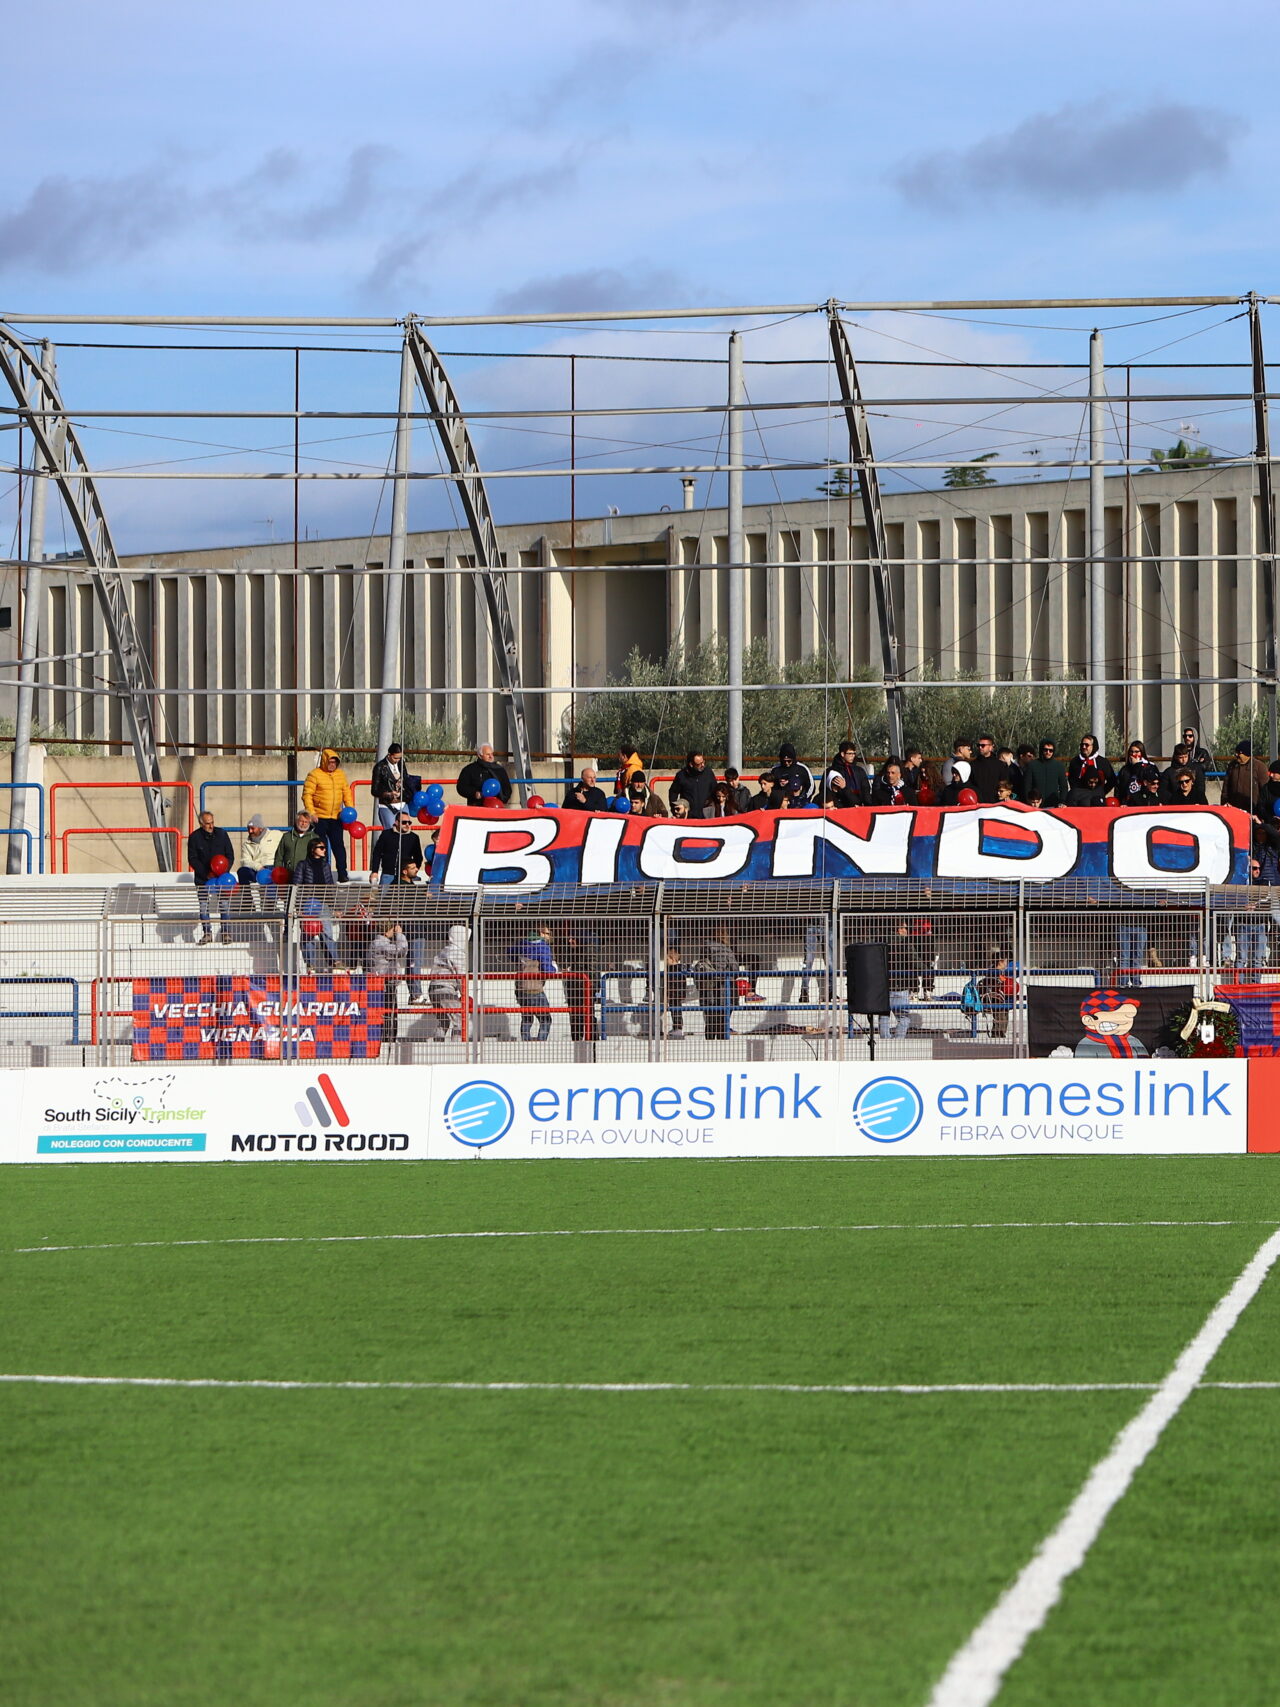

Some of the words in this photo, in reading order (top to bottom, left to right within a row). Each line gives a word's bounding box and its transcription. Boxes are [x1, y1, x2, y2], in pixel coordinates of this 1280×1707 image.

[443, 805, 1234, 895] BIONDO
[153, 1001, 249, 1018] VECCHIA
[256, 1001, 362, 1017] GUARDIA
[200, 1027, 315, 1043] VIGNAZZA
[528, 1073, 822, 1122] ermeslink
[937, 1070, 1232, 1117] ermeslink
[44, 1108, 91, 1122] South
[95, 1107, 137, 1124] Sicily
[141, 1107, 206, 1120] Transfer
[530, 1128, 596, 1145] FIBRA
[601, 1127, 715, 1145] OVUNQUE
[939, 1125, 1004, 1141] FIBRA
[1010, 1124, 1124, 1142] OVUNQUE
[50, 1140, 101, 1148] NOLEGGIO
[102, 1139, 124, 1148] CON
[126, 1138, 193, 1148] CONDUCENTE
[231, 1134, 317, 1152] MOTO
[324, 1134, 409, 1151] ROOD
